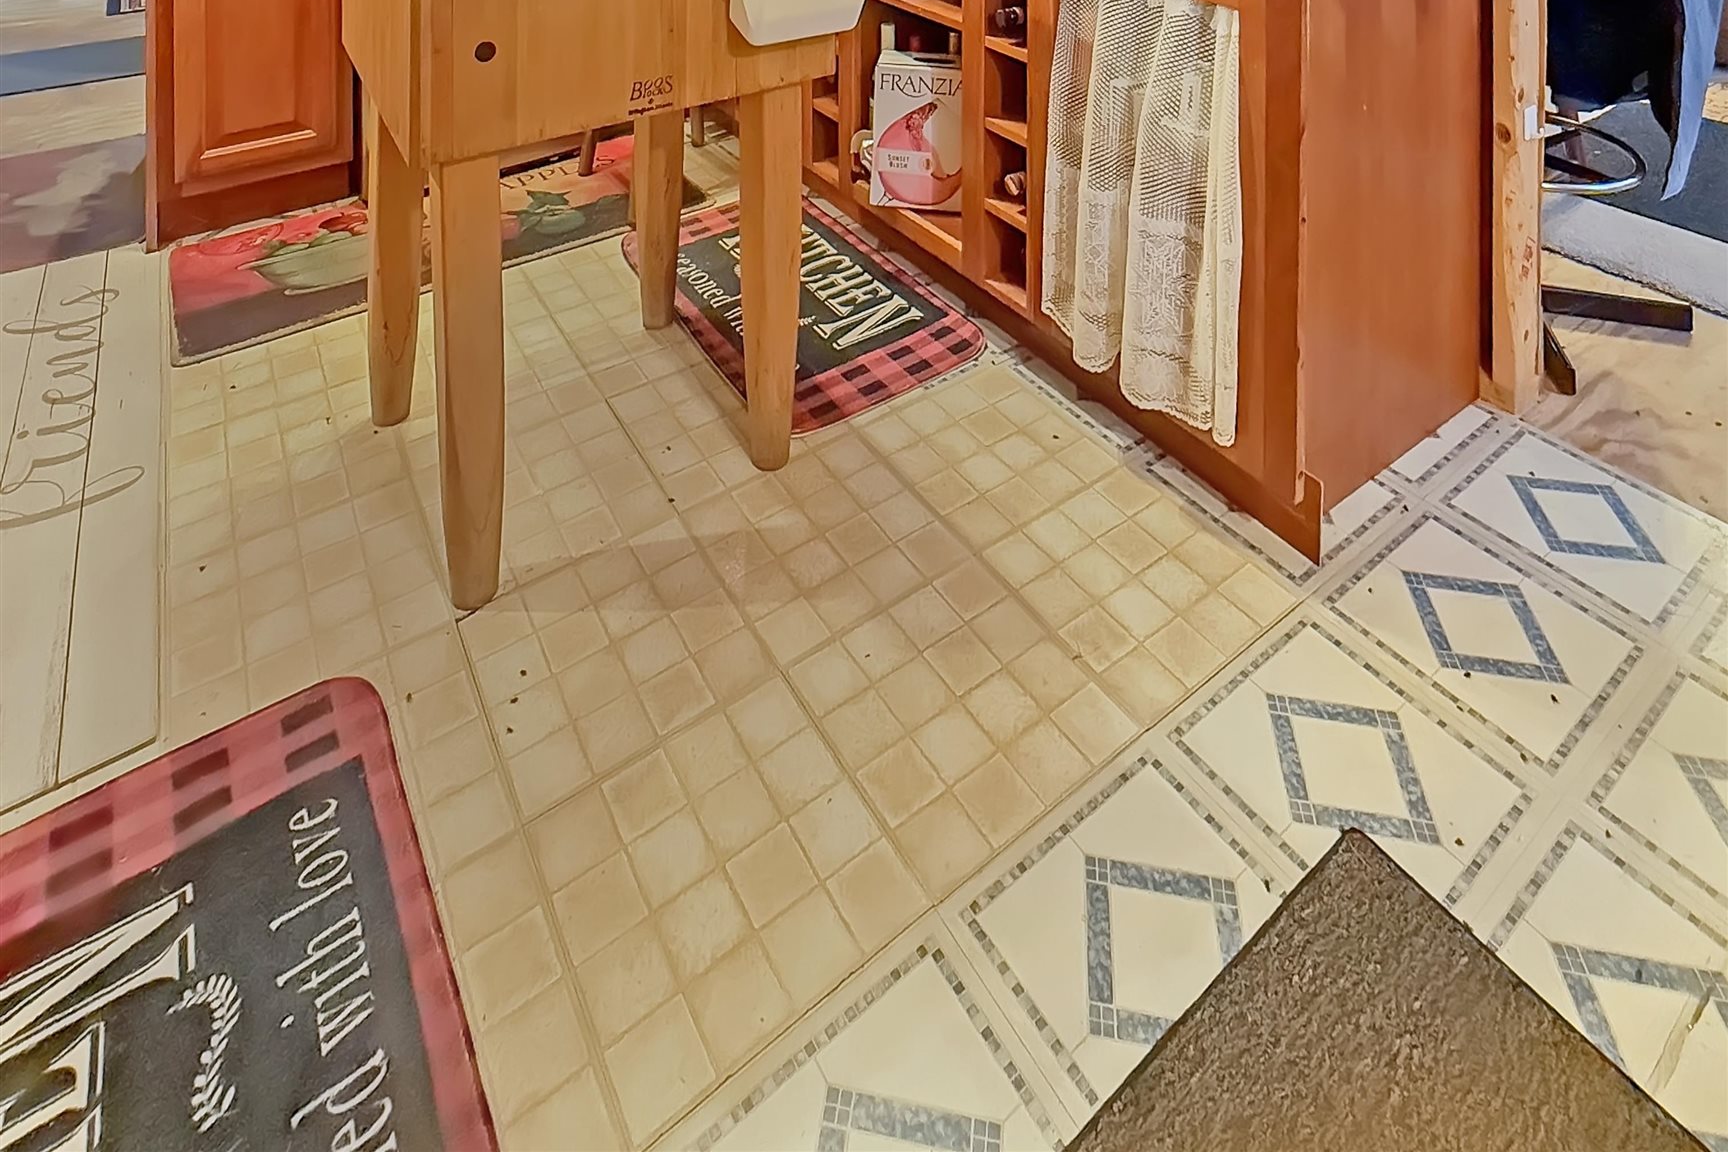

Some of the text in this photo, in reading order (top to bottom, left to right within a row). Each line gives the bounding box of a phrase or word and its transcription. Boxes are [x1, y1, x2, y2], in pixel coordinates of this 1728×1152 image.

[499, 155, 615, 189] PPLS
[269, 797, 354, 932] love
[275, 905, 376, 1058] with
